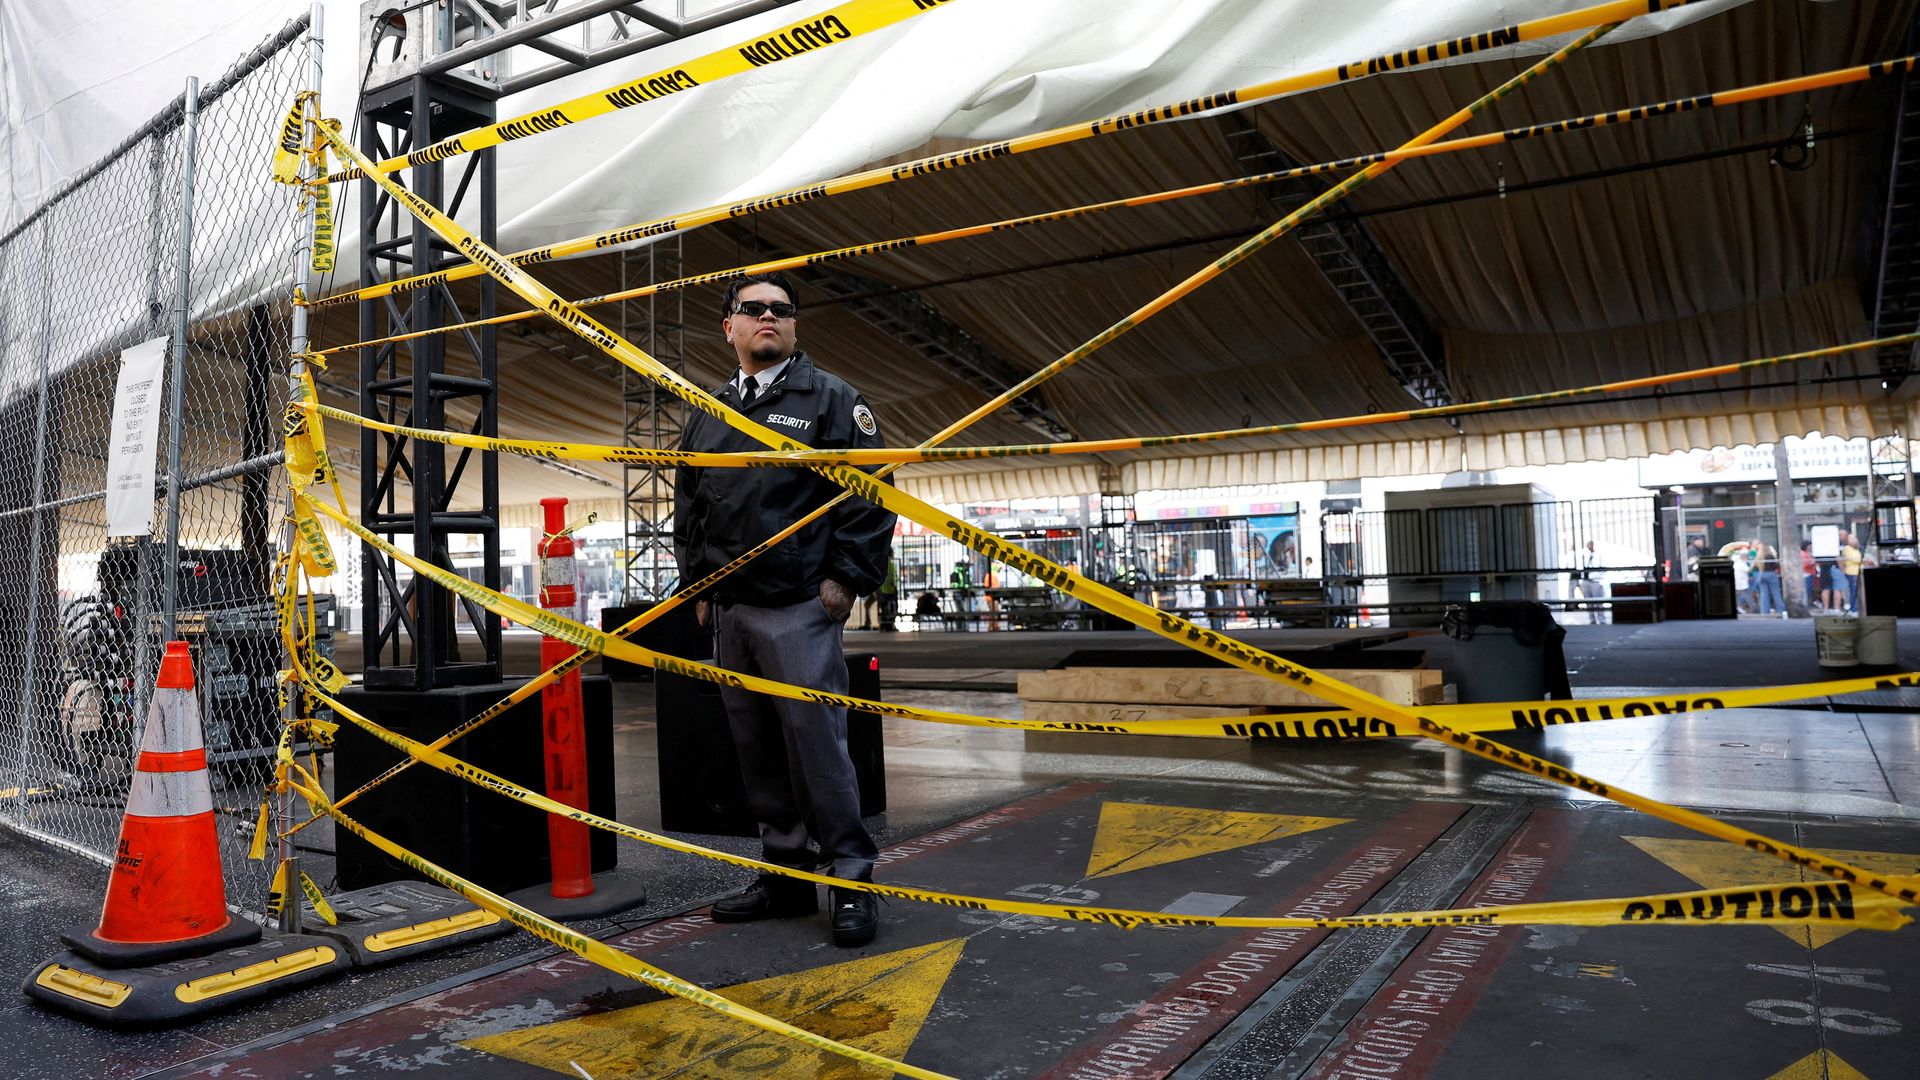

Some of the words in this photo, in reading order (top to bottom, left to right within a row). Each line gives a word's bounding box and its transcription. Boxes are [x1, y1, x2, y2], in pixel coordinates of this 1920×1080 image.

[738, 14, 852, 68] CAUTION
[604, 69, 700, 110] CAUTION
[496, 108, 574, 143] CAUTION
[549, 298, 619, 350] CAUTION
[767, 414, 811, 430] SECURITY
[1622, 884, 1855, 921] CAUTION
[1388, 969, 1466, 1015] OPEN
[1068, 997, 1219, 1080] WARNING!
[1187, 951, 1278, 995] DOOR
